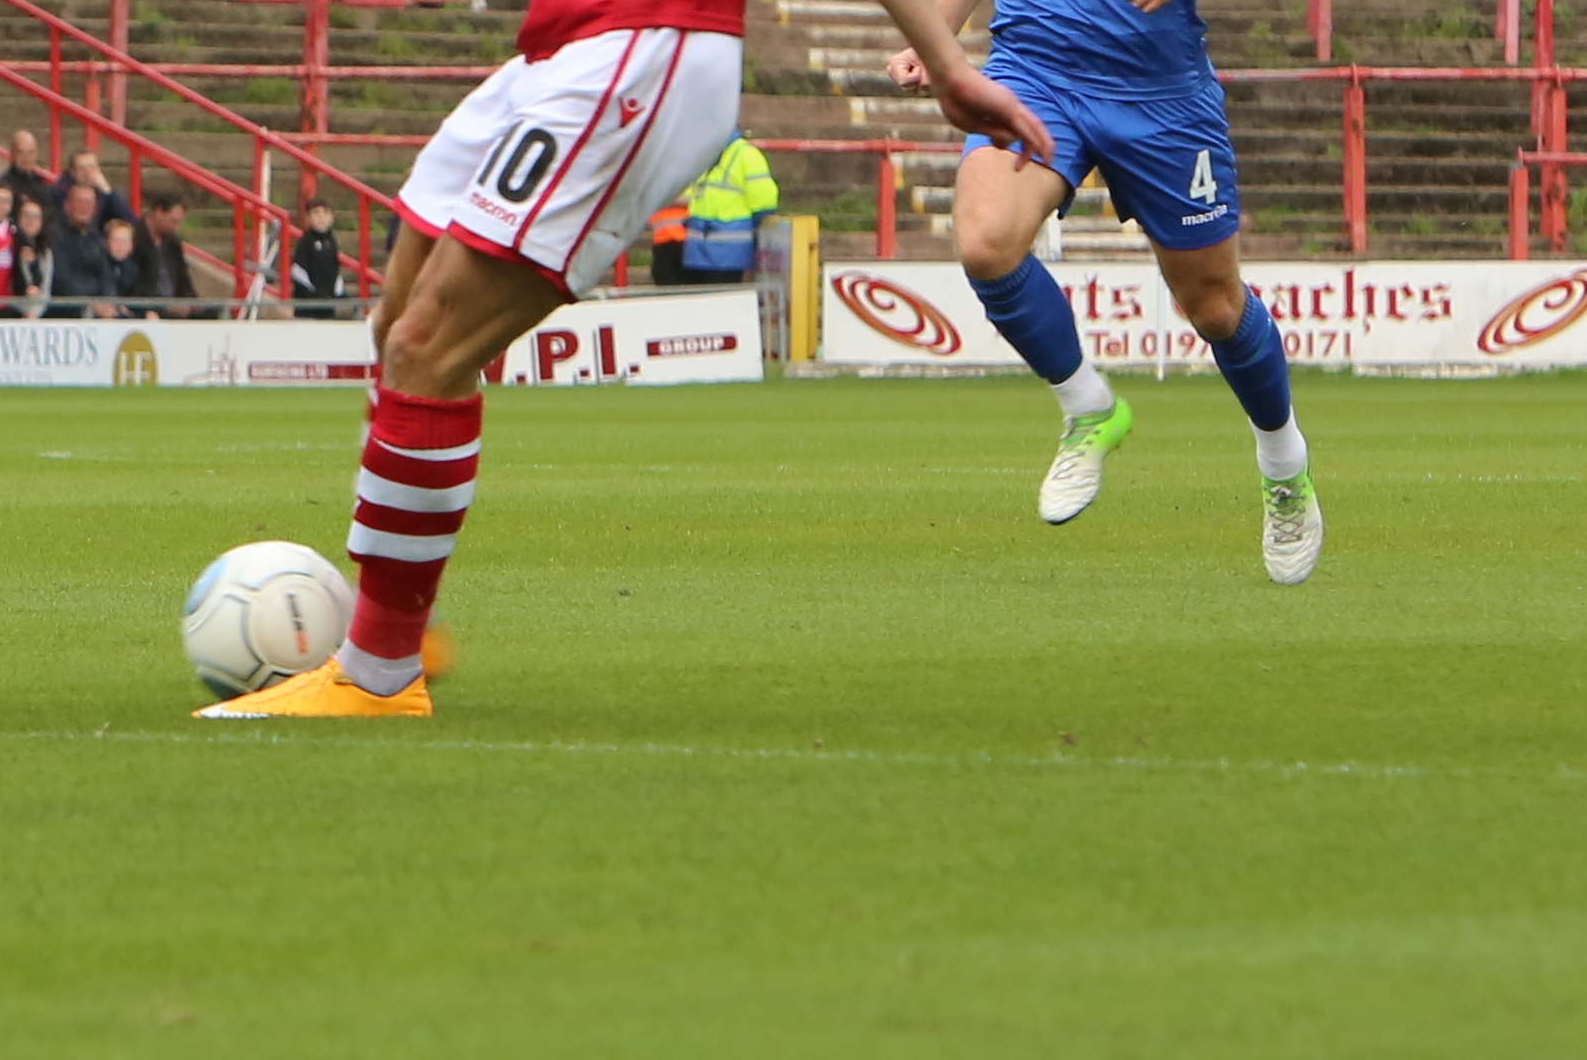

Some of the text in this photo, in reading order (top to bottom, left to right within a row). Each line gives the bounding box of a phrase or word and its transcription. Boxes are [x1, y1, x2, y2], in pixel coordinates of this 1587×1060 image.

[477, 118, 557, 203] 10
[1189, 149, 1217, 205] 4
[468, 191, 517, 224] macron
[1181, 204, 1227, 226] macron
[659, 337, 724, 355] GROUP
[1086, 330, 1128, 356] Tel
